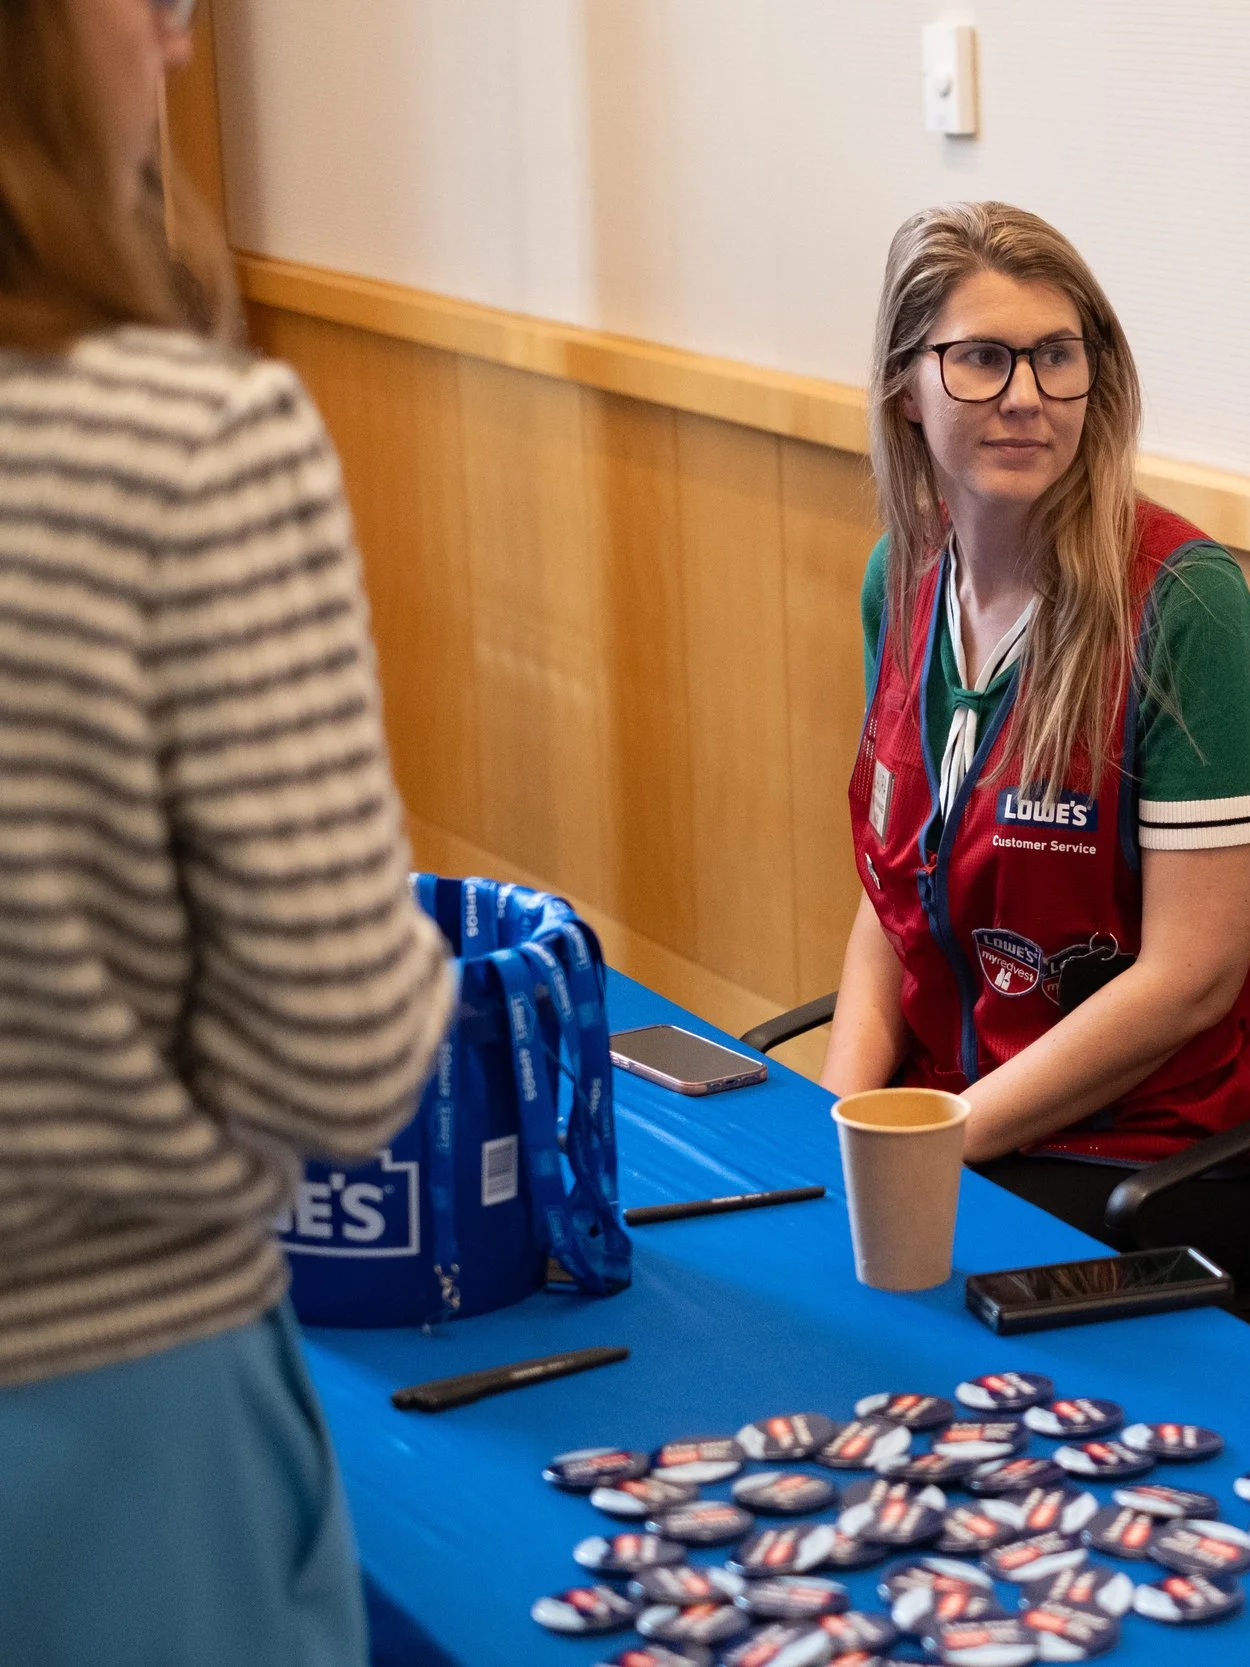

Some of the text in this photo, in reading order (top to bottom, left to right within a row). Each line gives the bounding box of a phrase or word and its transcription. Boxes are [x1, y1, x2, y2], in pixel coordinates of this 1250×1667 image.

[1004, 793, 1088, 827] LOWE'S
[992, 834, 1097, 855] Customer Service
[983, 934, 1036, 964] LOWE'S
[982, 950, 1035, 983] myredvest
